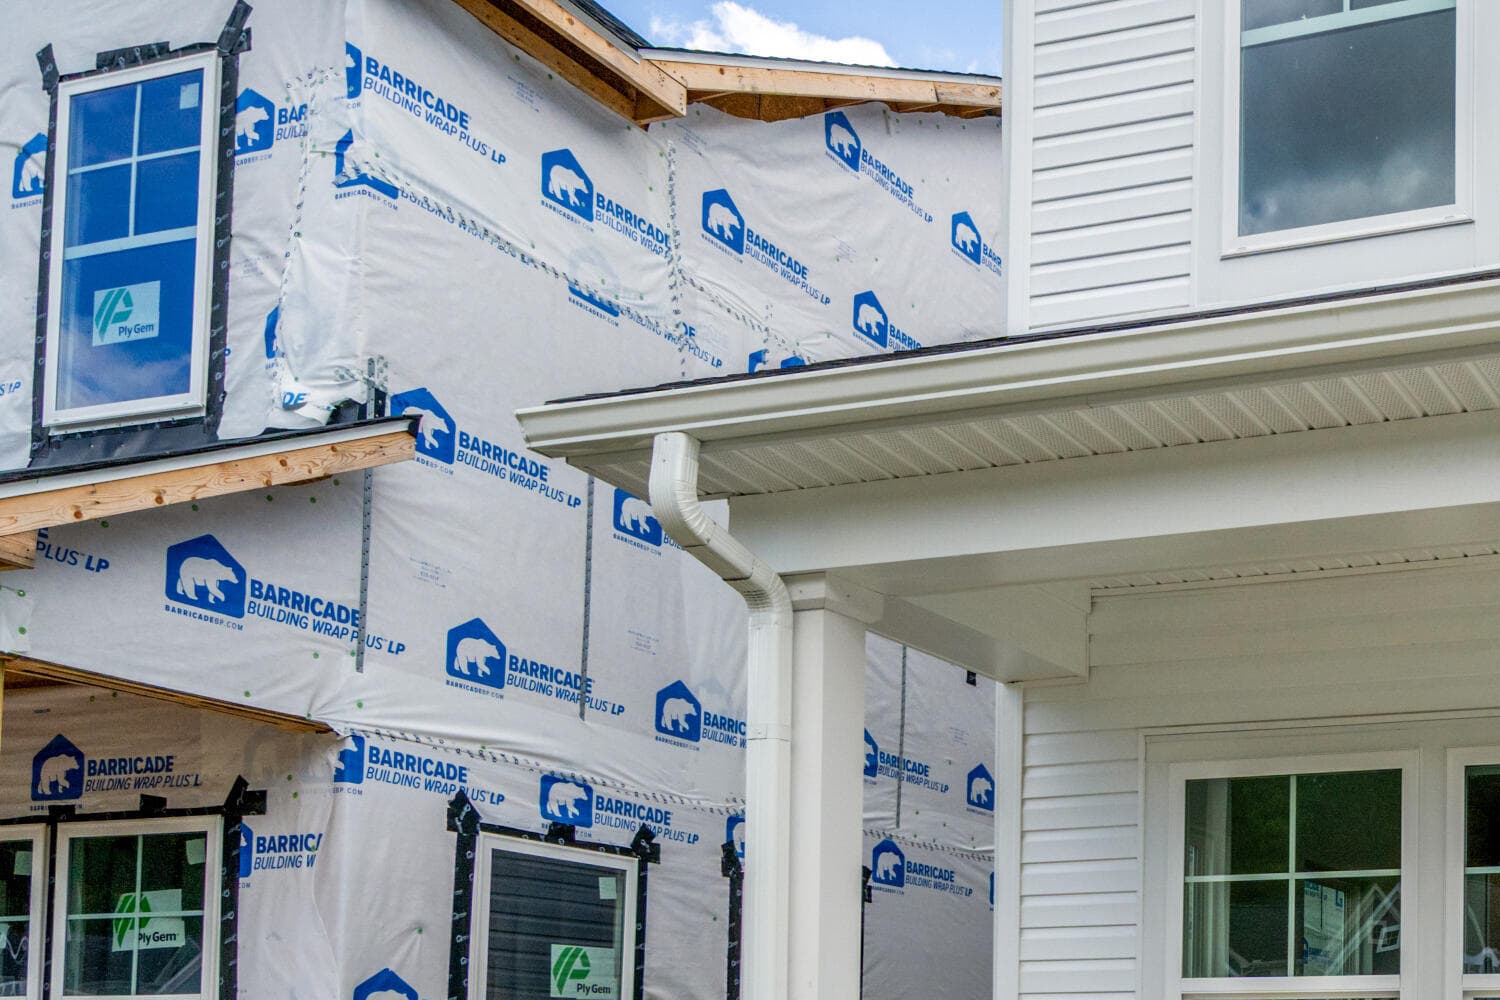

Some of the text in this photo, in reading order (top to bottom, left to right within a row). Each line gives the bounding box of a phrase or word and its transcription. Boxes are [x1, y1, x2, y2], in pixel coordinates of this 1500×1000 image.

[366, 56, 469, 130] BARRICADE
[363, 76, 421, 118] BUILDING
[425, 109, 458, 136] WRAP
[458, 131, 488, 156] PLUS
[491, 149, 507, 165] LP
[861, 148, 914, 199] BARRICADE
[595, 210, 663, 256] BUILDING WRAP
[924, 212, 934, 224] LP
[746, 228, 808, 281] BARRICADE
[745, 243, 831, 306] BUILDING WRAP PLUS LP
[118, 323, 154, 338] Ply Gem
[710, 356, 723, 369] LP
[458, 430, 550, 482] BARRICADE
[456, 450, 582, 508] BUILDING WRAP PLUS LP
[36, 541, 110, 573] PLUS LP
[250, 579, 360, 627] BARRICADE
[247, 600, 406, 655] BUILDING WRAP PUS LP
[507, 673, 553, 697] BUILDING
[610, 703, 625, 716] LP
[702, 727, 737, 747] BUILDING
[87, 755, 175, 777] BARRICADE
[368, 746, 468, 783] BARRICADE
[85, 776, 131, 792] BUILDING
[133, 776, 163, 789] WRAP
[163, 774, 191, 788] PLUS
[366, 767, 421, 789] BUILDING
[424, 778, 456, 796] WRAP
[489, 793, 505, 806] LP
[906, 772, 923, 786] WRAP
[940, 783, 949, 793] LP
[595, 795, 671, 826] BARRICADE
[594, 813, 636, 832] BUILDING
[663, 828, 686, 842] PLUS
[687, 833, 699, 845] LP
[254, 855, 303, 870] BUILDING
[906, 861, 955, 882] BARRICADE
[964, 888, 973, 897] LP
[152, 931, 176, 942] Gem
[577, 983, 611, 996] Ply Gem
